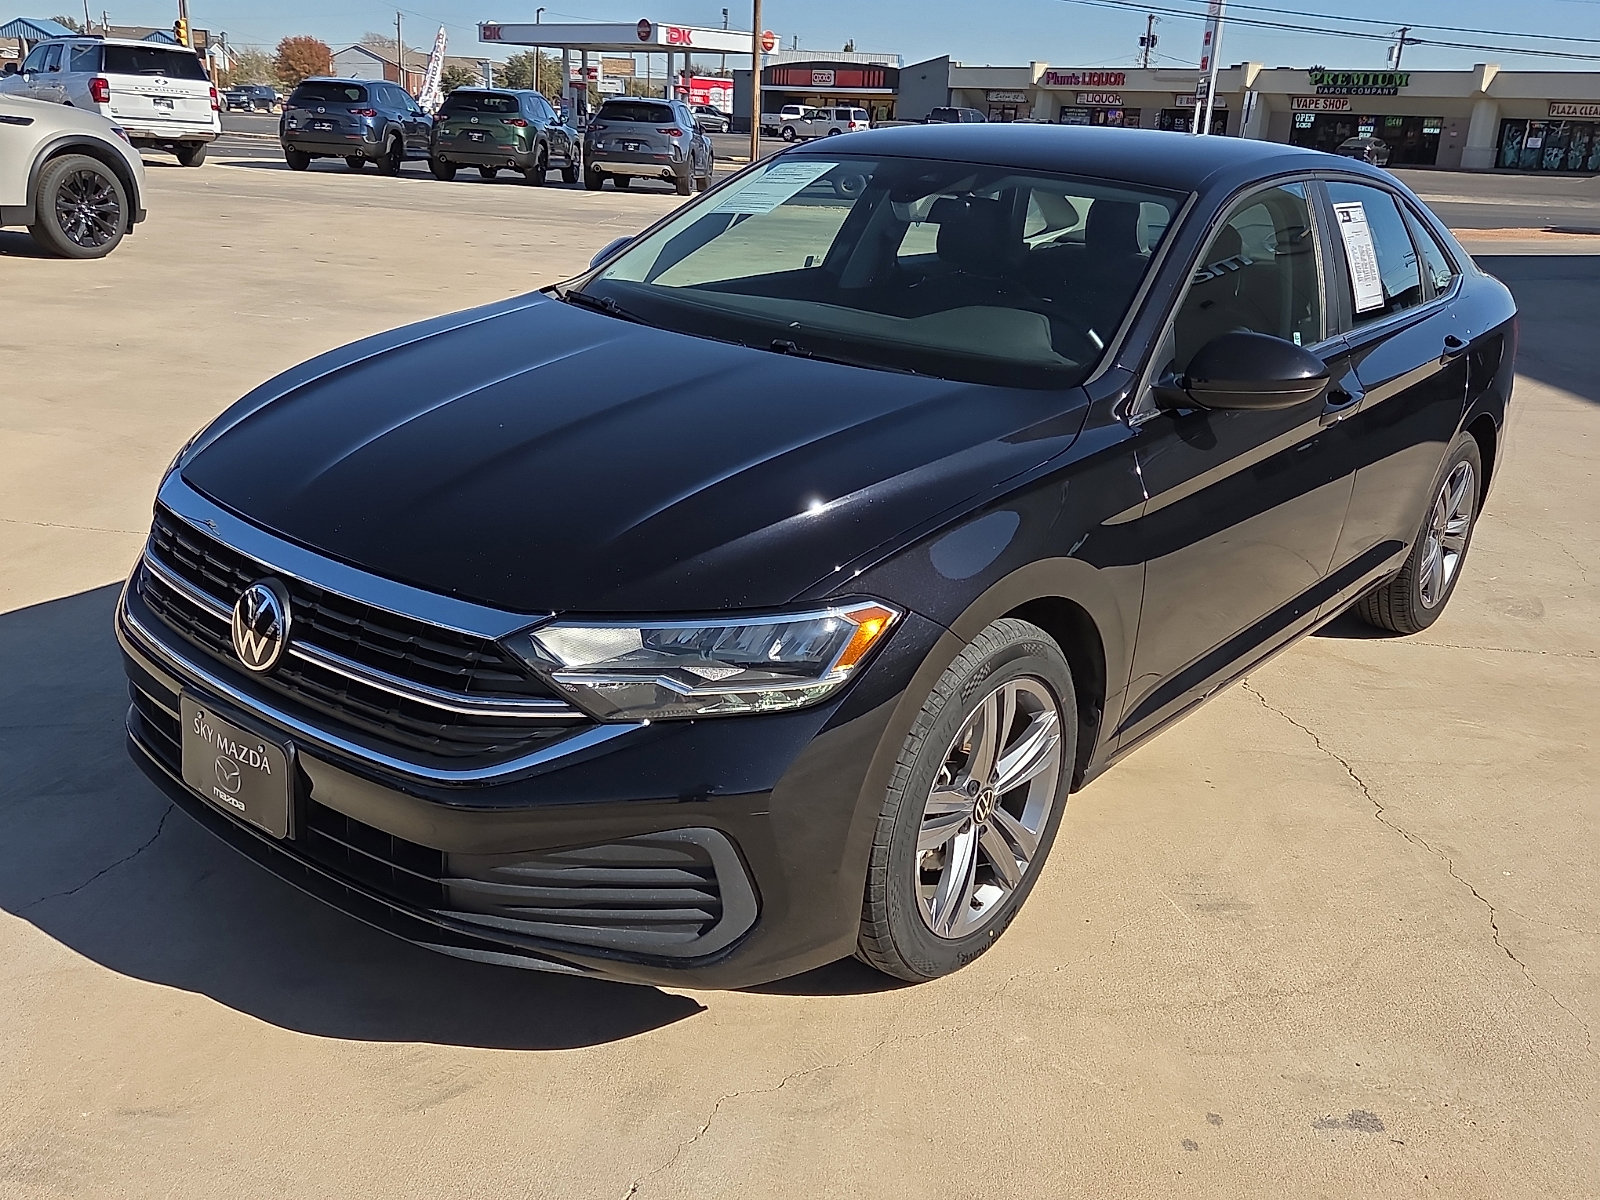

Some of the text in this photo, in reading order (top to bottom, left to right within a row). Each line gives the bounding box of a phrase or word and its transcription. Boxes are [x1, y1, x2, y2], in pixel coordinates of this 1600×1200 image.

[483, 26, 502, 39] DK
[666, 26, 692, 45] DK
[1046, 72, 1125, 86] Plum's LIQUOR
[1310, 72, 1410, 87] PREMIUM
[1086, 93, 1121, 103] LIQUOR
[1296, 98, 1349, 110] VAPE SHOP
[1551, 105, 1600, 116] PLAZA CLEA
[193, 717, 271, 775] SKY MAZDA
[213, 786, 246, 812] mazda
